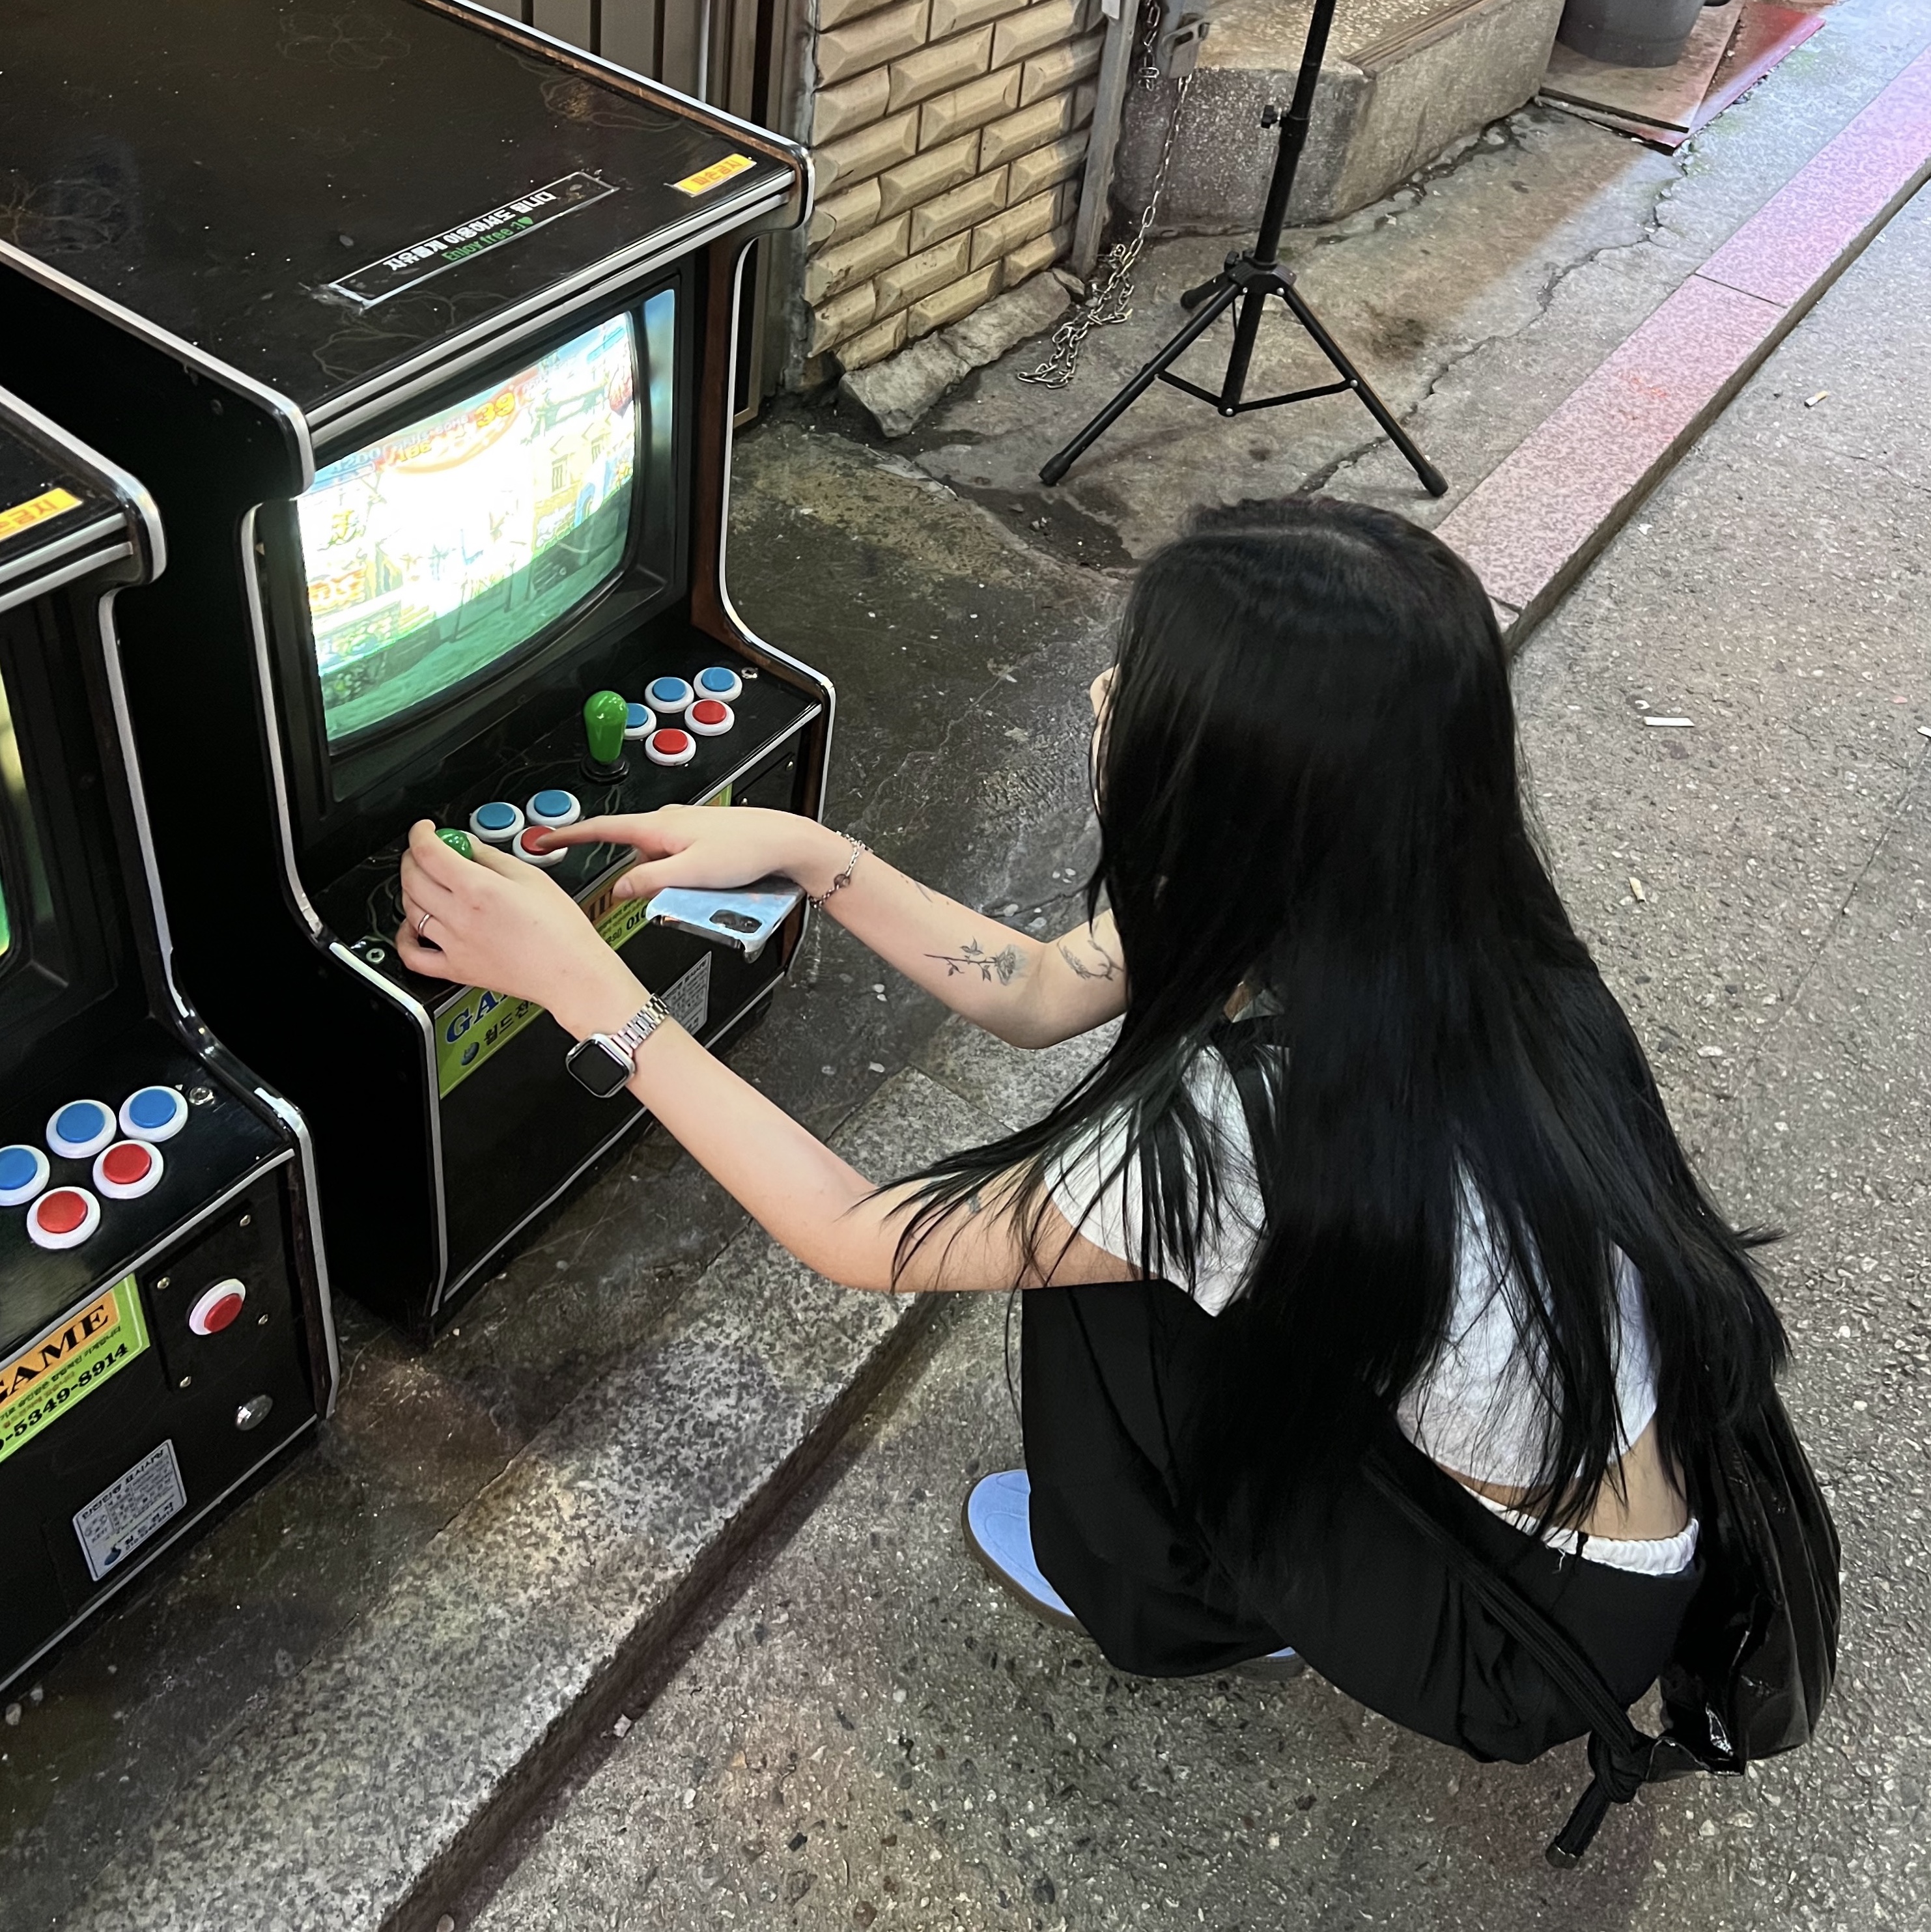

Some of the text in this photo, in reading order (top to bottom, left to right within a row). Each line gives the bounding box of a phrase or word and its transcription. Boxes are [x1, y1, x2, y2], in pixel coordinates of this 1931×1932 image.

[690, 160, 742, 185] 파손금지
[383, 240, 448, 271] 자유롭게
[441, 240, 483, 261] Enjoy
[479, 221, 514, 245] free
[475, 391, 515, 428] 39
[445, 990, 509, 1043] GA
